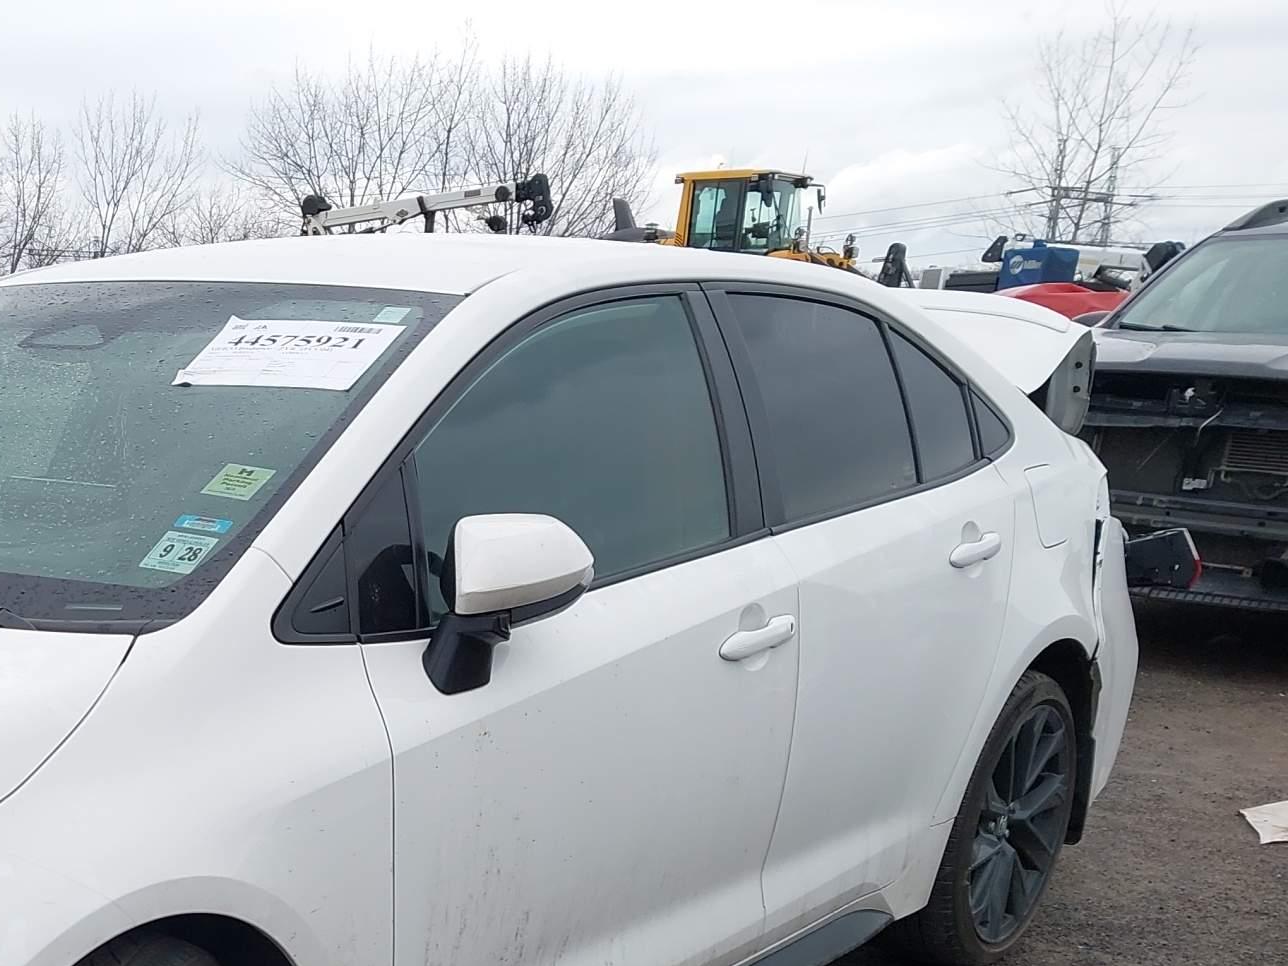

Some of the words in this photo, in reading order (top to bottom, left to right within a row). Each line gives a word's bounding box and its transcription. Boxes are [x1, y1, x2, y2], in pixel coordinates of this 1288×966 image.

[227, 334, 366, 349] 44575921
[159, 544, 175, 558] 9
[178, 546, 202, 561] 28
